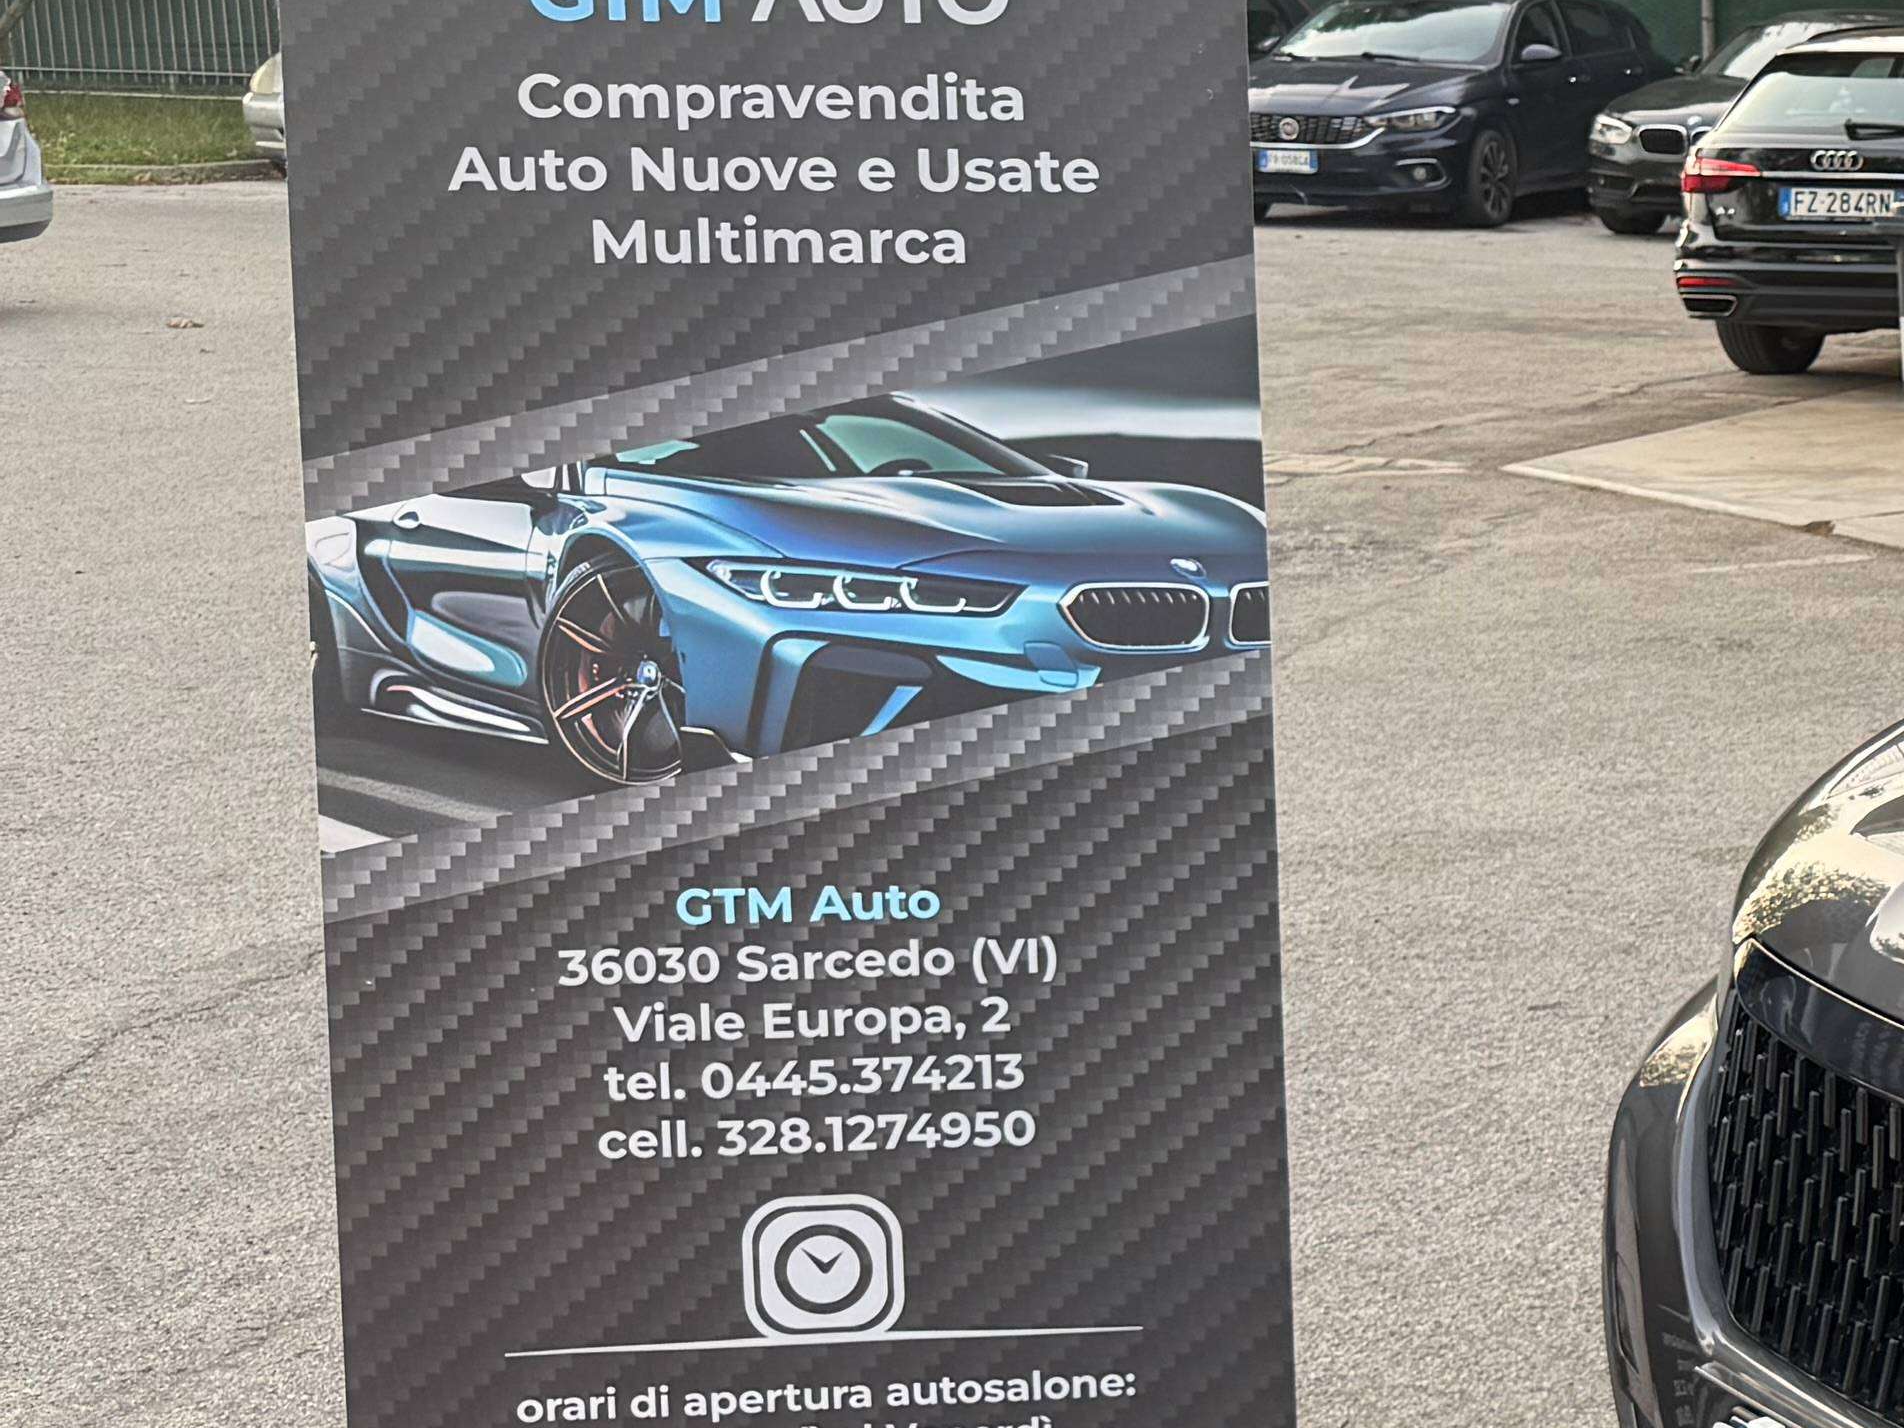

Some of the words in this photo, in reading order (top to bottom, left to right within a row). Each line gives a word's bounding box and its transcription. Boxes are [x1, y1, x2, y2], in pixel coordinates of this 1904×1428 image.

[517, 71, 1024, 131] Compravendita
[447, 146, 608, 192] Auto
[630, 146, 838, 192] Nuove
[857, 157, 896, 192] e
[917, 148, 1100, 193] Usate
[1795, 191, 1818, 213] FZ
[1827, 192, 1892, 214] 284RN
[592, 214, 966, 264] Multimarca
[676, 886, 793, 926] GTM
[809, 885, 941, 923] Auto
[557, 946, 720, 987] 36030
[736, 938, 955, 982] Sarcedo
[972, 935, 1057, 985] (VI)
[612, 1001, 746, 1043] Viale
[763, 1002, 967, 1044] Europa,
[980, 996, 1011, 1033] 2
[603, 1061, 686, 1102] tel.
[700, 1053, 1025, 1099] 0445.374213
[598, 1119, 703, 1159] cell.
[716, 1109, 1036, 1157] 328.1274950
[516, 1386, 617, 1423] orari
[630, 1384, 670, 1419] di
[683, 1383, 873, 1423] apertura
[886, 1369, 1136, 1407] autosalone:
